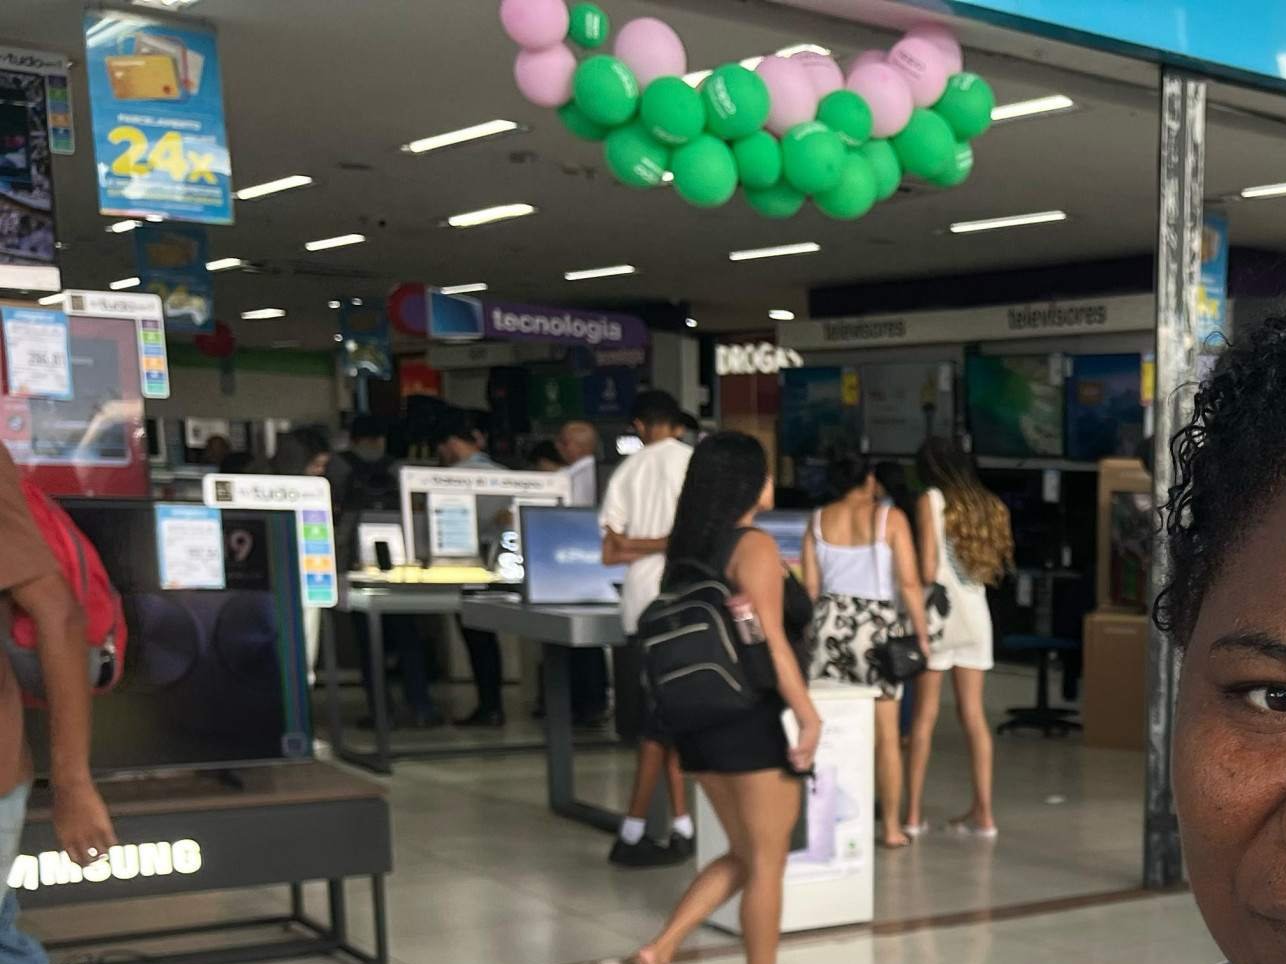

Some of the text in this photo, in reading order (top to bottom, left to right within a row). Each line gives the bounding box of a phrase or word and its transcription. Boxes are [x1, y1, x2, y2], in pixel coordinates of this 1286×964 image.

[492, 306, 622, 344] tecnologia
[823, 320, 906, 342] televisores
[1007, 305, 1107, 330] televisores
[6, 839, 202, 891] AMSUNG
